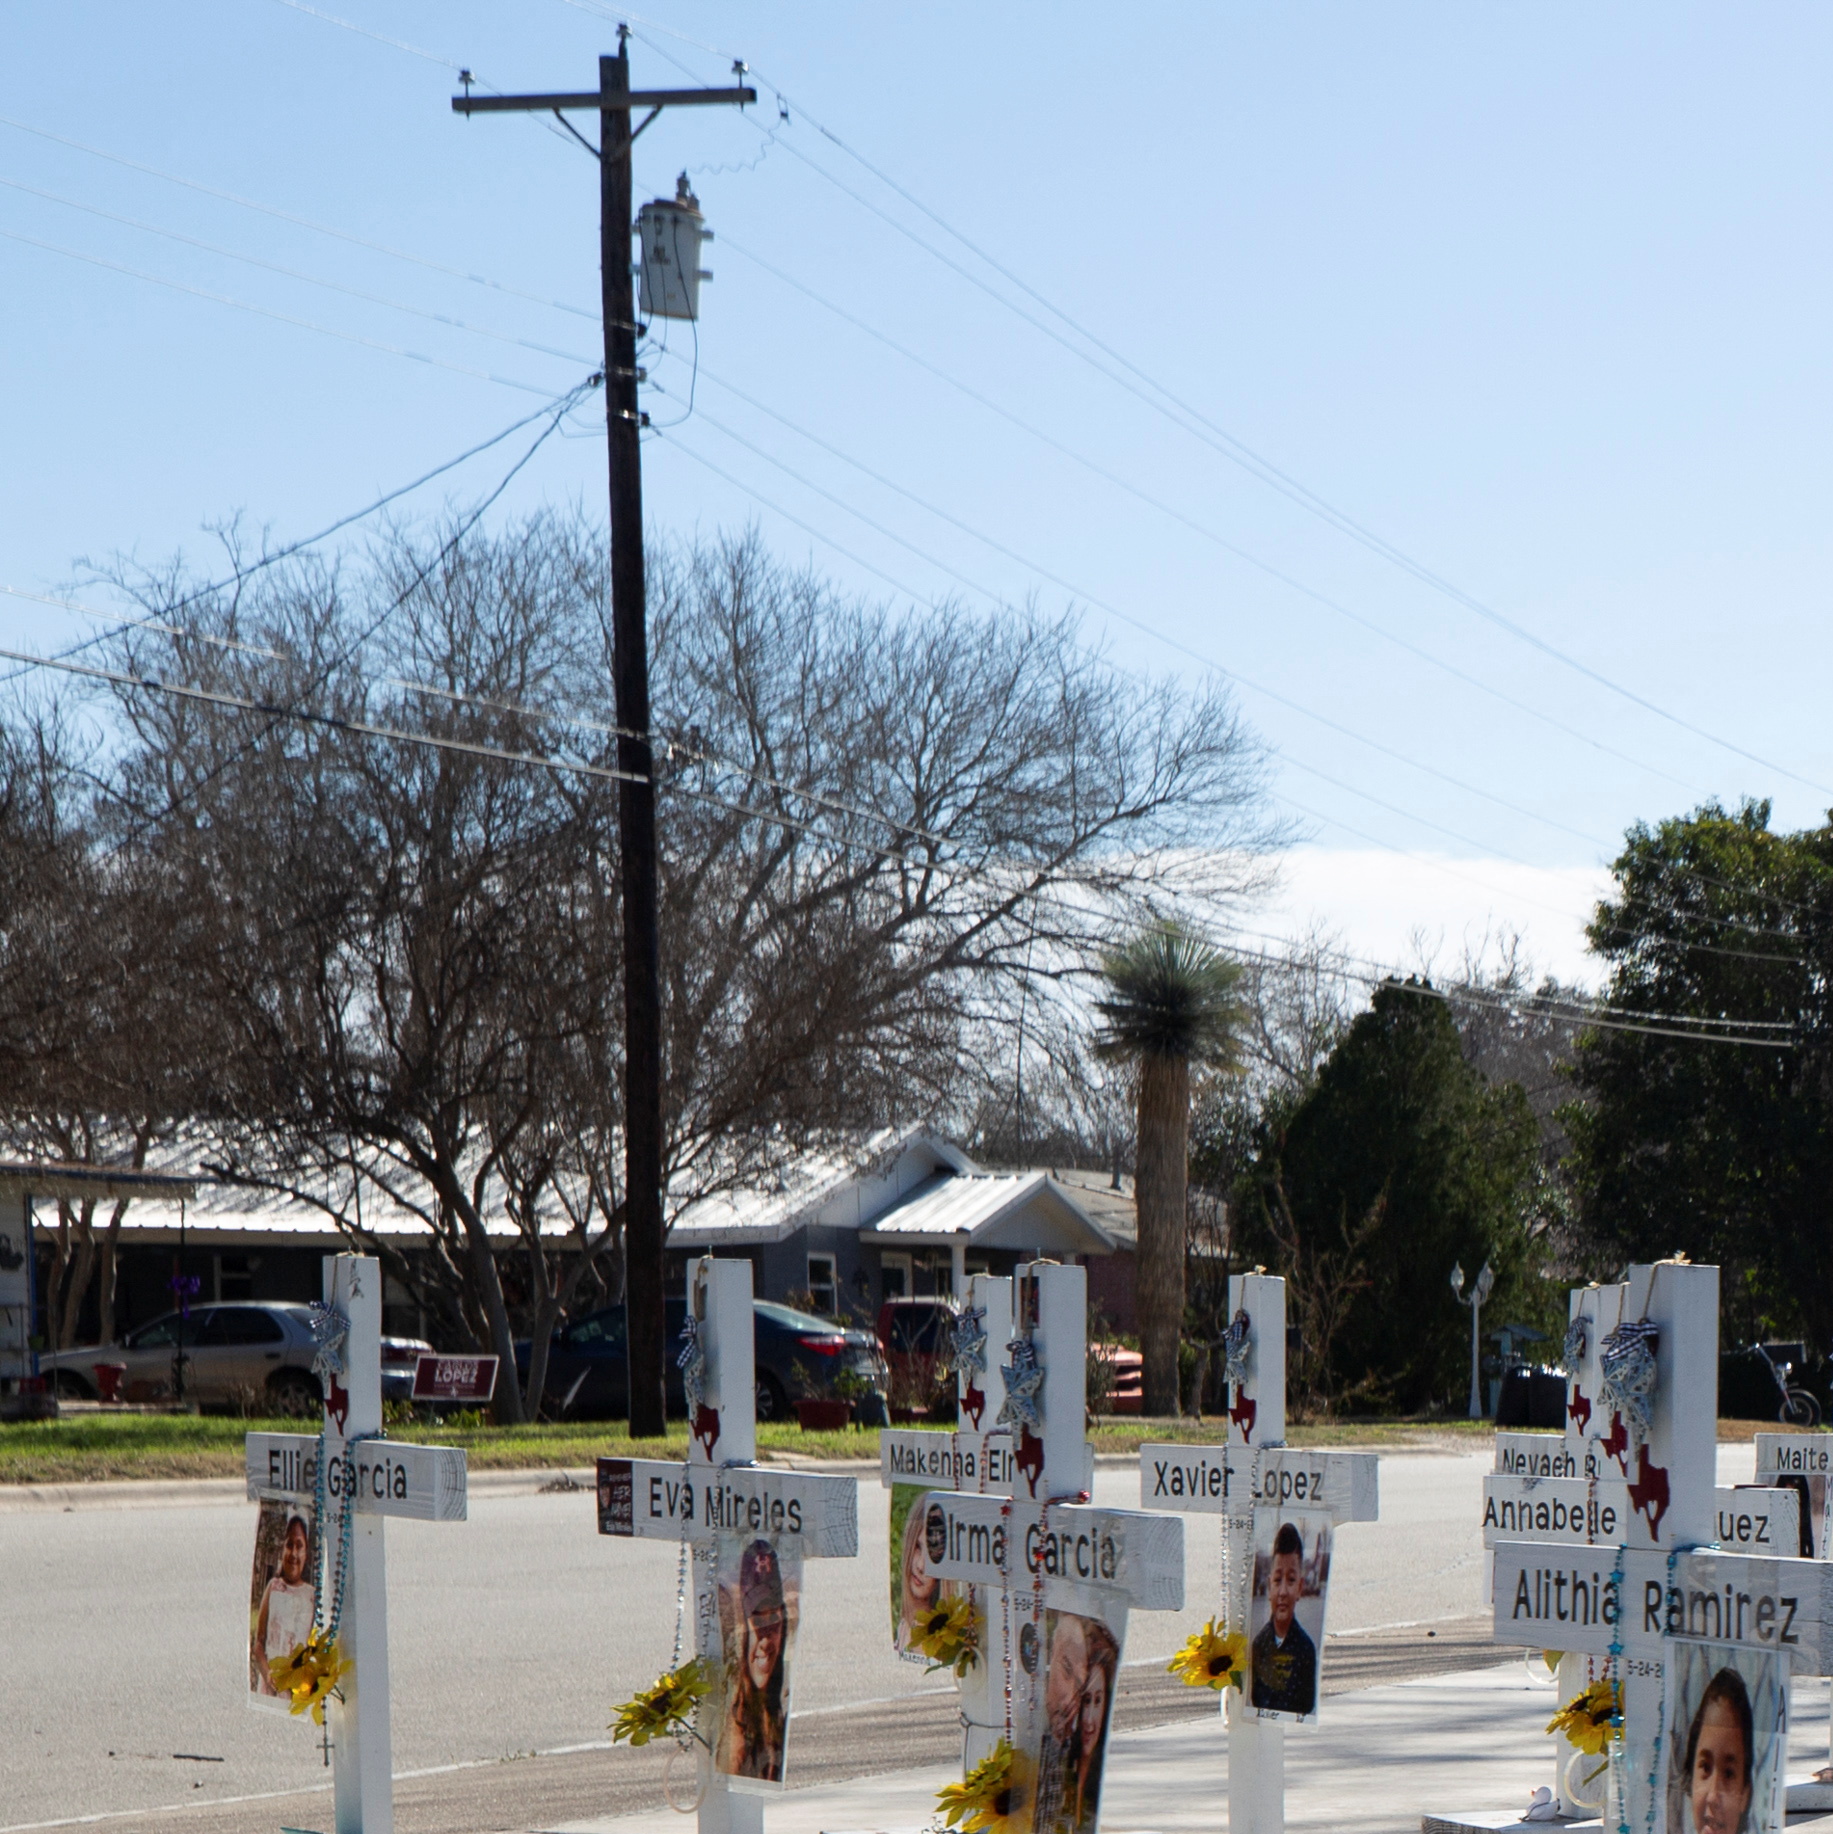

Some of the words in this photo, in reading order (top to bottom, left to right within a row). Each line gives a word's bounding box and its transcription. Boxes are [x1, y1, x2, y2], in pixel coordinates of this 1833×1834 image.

[435, 1368, 478, 1383] LOPEZ
[268, 1449, 317, 1493] Ellie
[327, 1457, 408, 1500] Garcia
[890, 1443, 976, 1478] Makenna
[989, 1450, 1014, 1482] Elr
[1154, 1460, 1235, 1497] Xavier
[1502, 1448, 1576, 1478] Nevaeh
[1776, 1447, 1829, 1471] Maite
[649, 1477, 695, 1521] Eva
[705, 1486, 802, 1534] Mireles
[1482, 1496, 1617, 1535] Annabele
[948, 1512, 1007, 1566] Irma
[1026, 1524, 1116, 1580] Garcia
[1512, 1569, 1620, 1626] Alithia
[1643, 1580, 1799, 1644] Ramirez
[1628, 1660, 1663, 1678] 5-24-2
